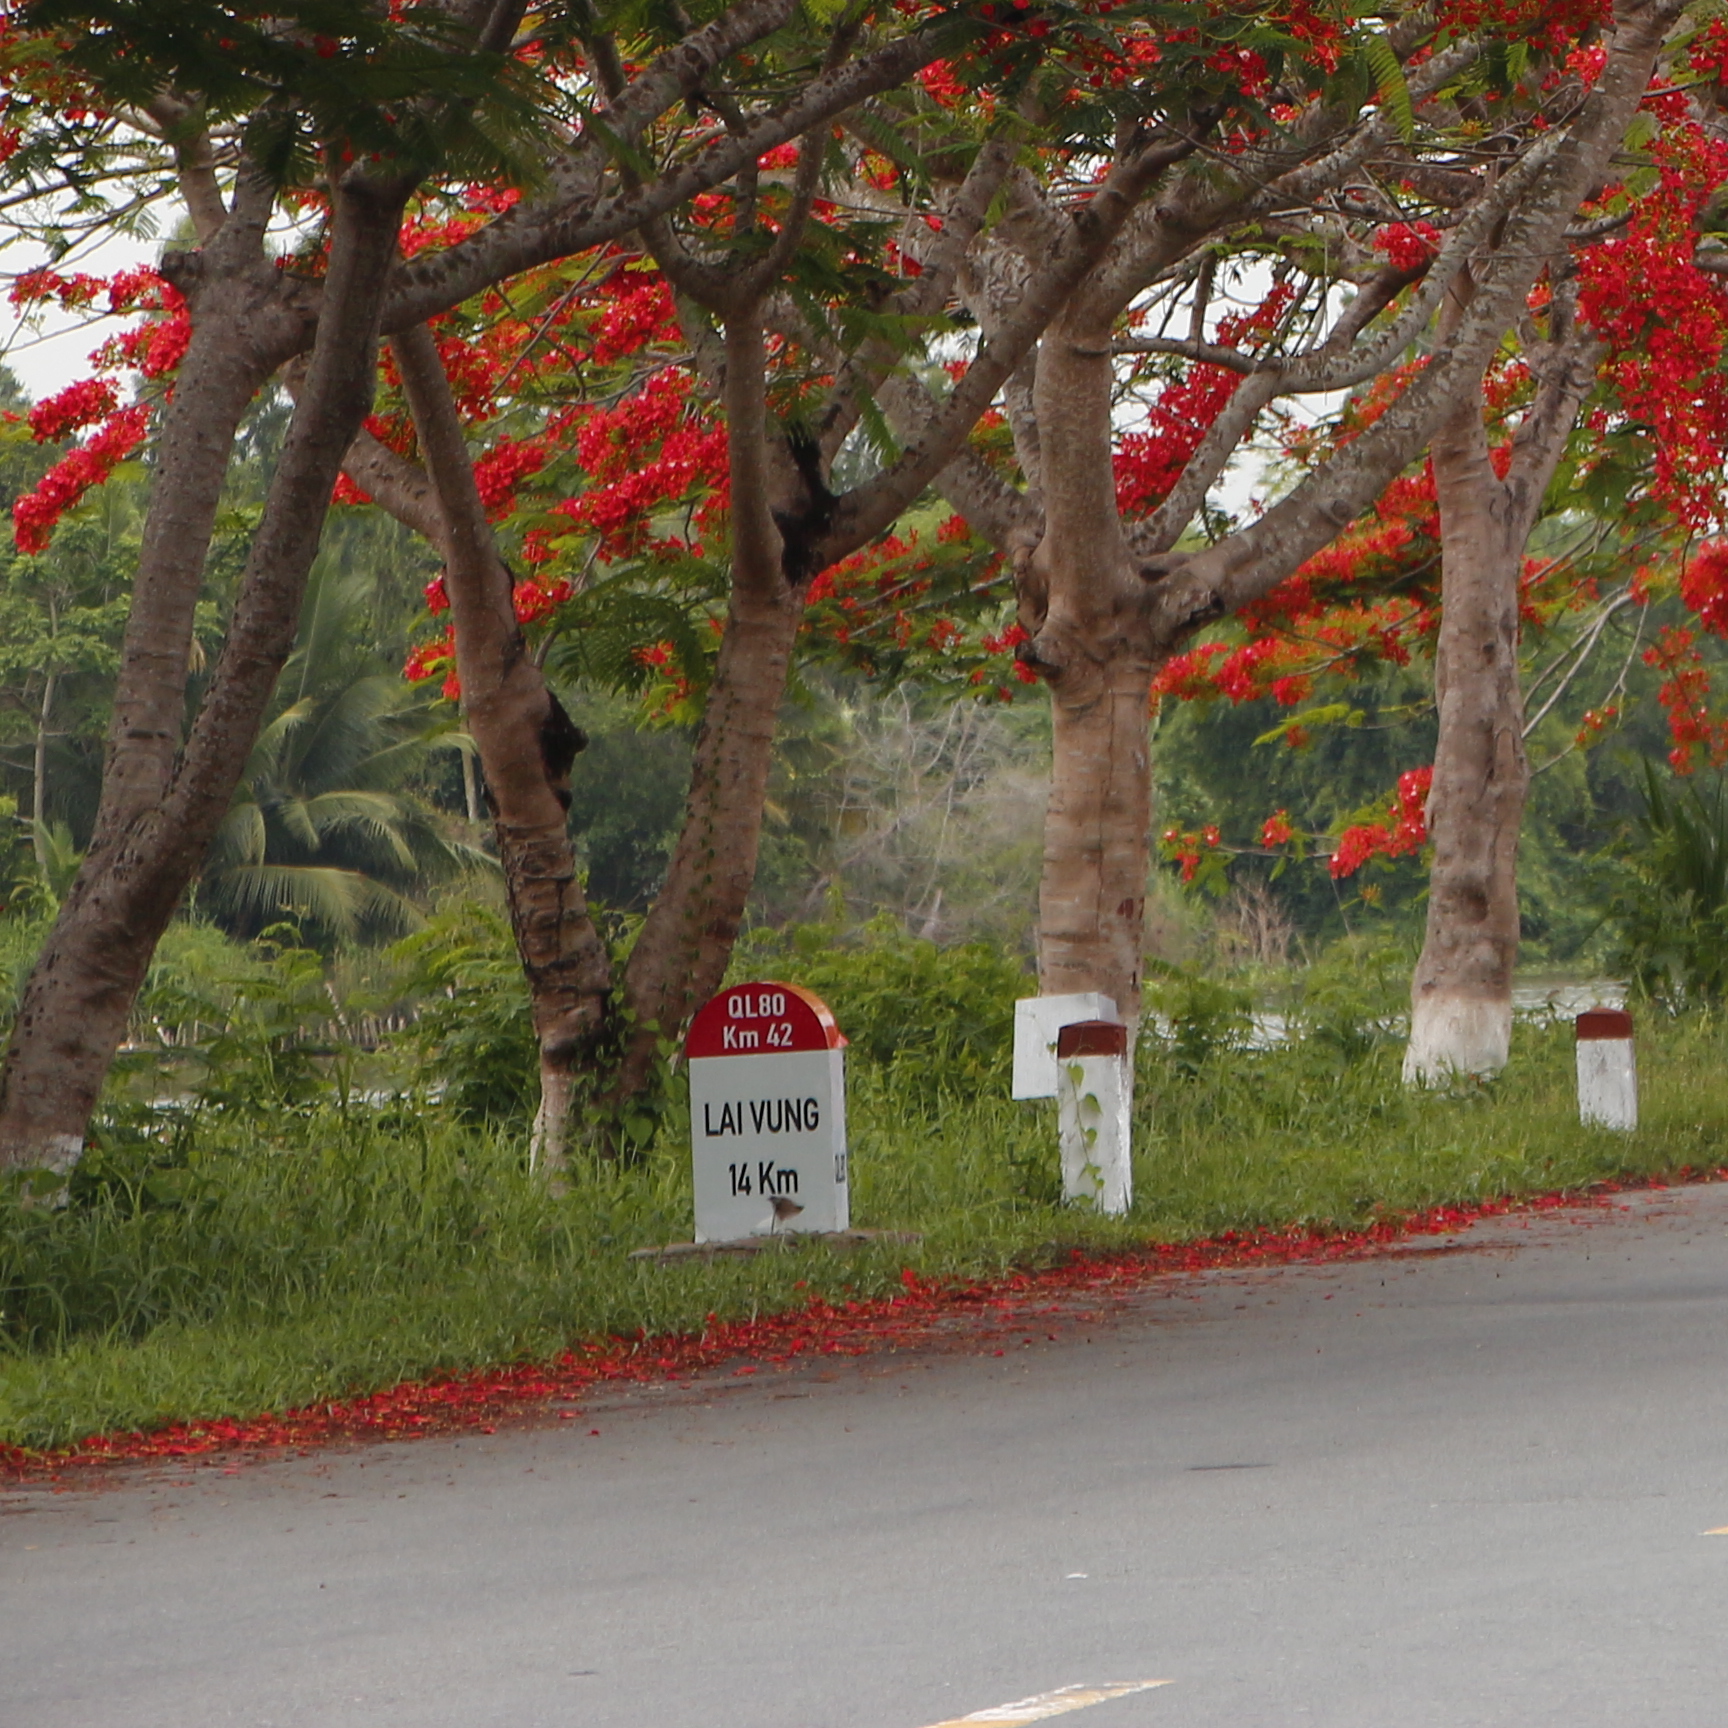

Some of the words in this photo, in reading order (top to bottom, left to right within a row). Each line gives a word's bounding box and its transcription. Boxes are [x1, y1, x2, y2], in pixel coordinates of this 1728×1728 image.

[728, 993, 786, 1019] QL80
[723, 1025, 759, 1049] Km
[766, 1023, 793, 1047] 42
[704, 1100, 743, 1137] LAI
[749, 1097, 820, 1135] VUNG
[729, 1162, 752, 1197] 14
[758, 1161, 799, 1195] Km
